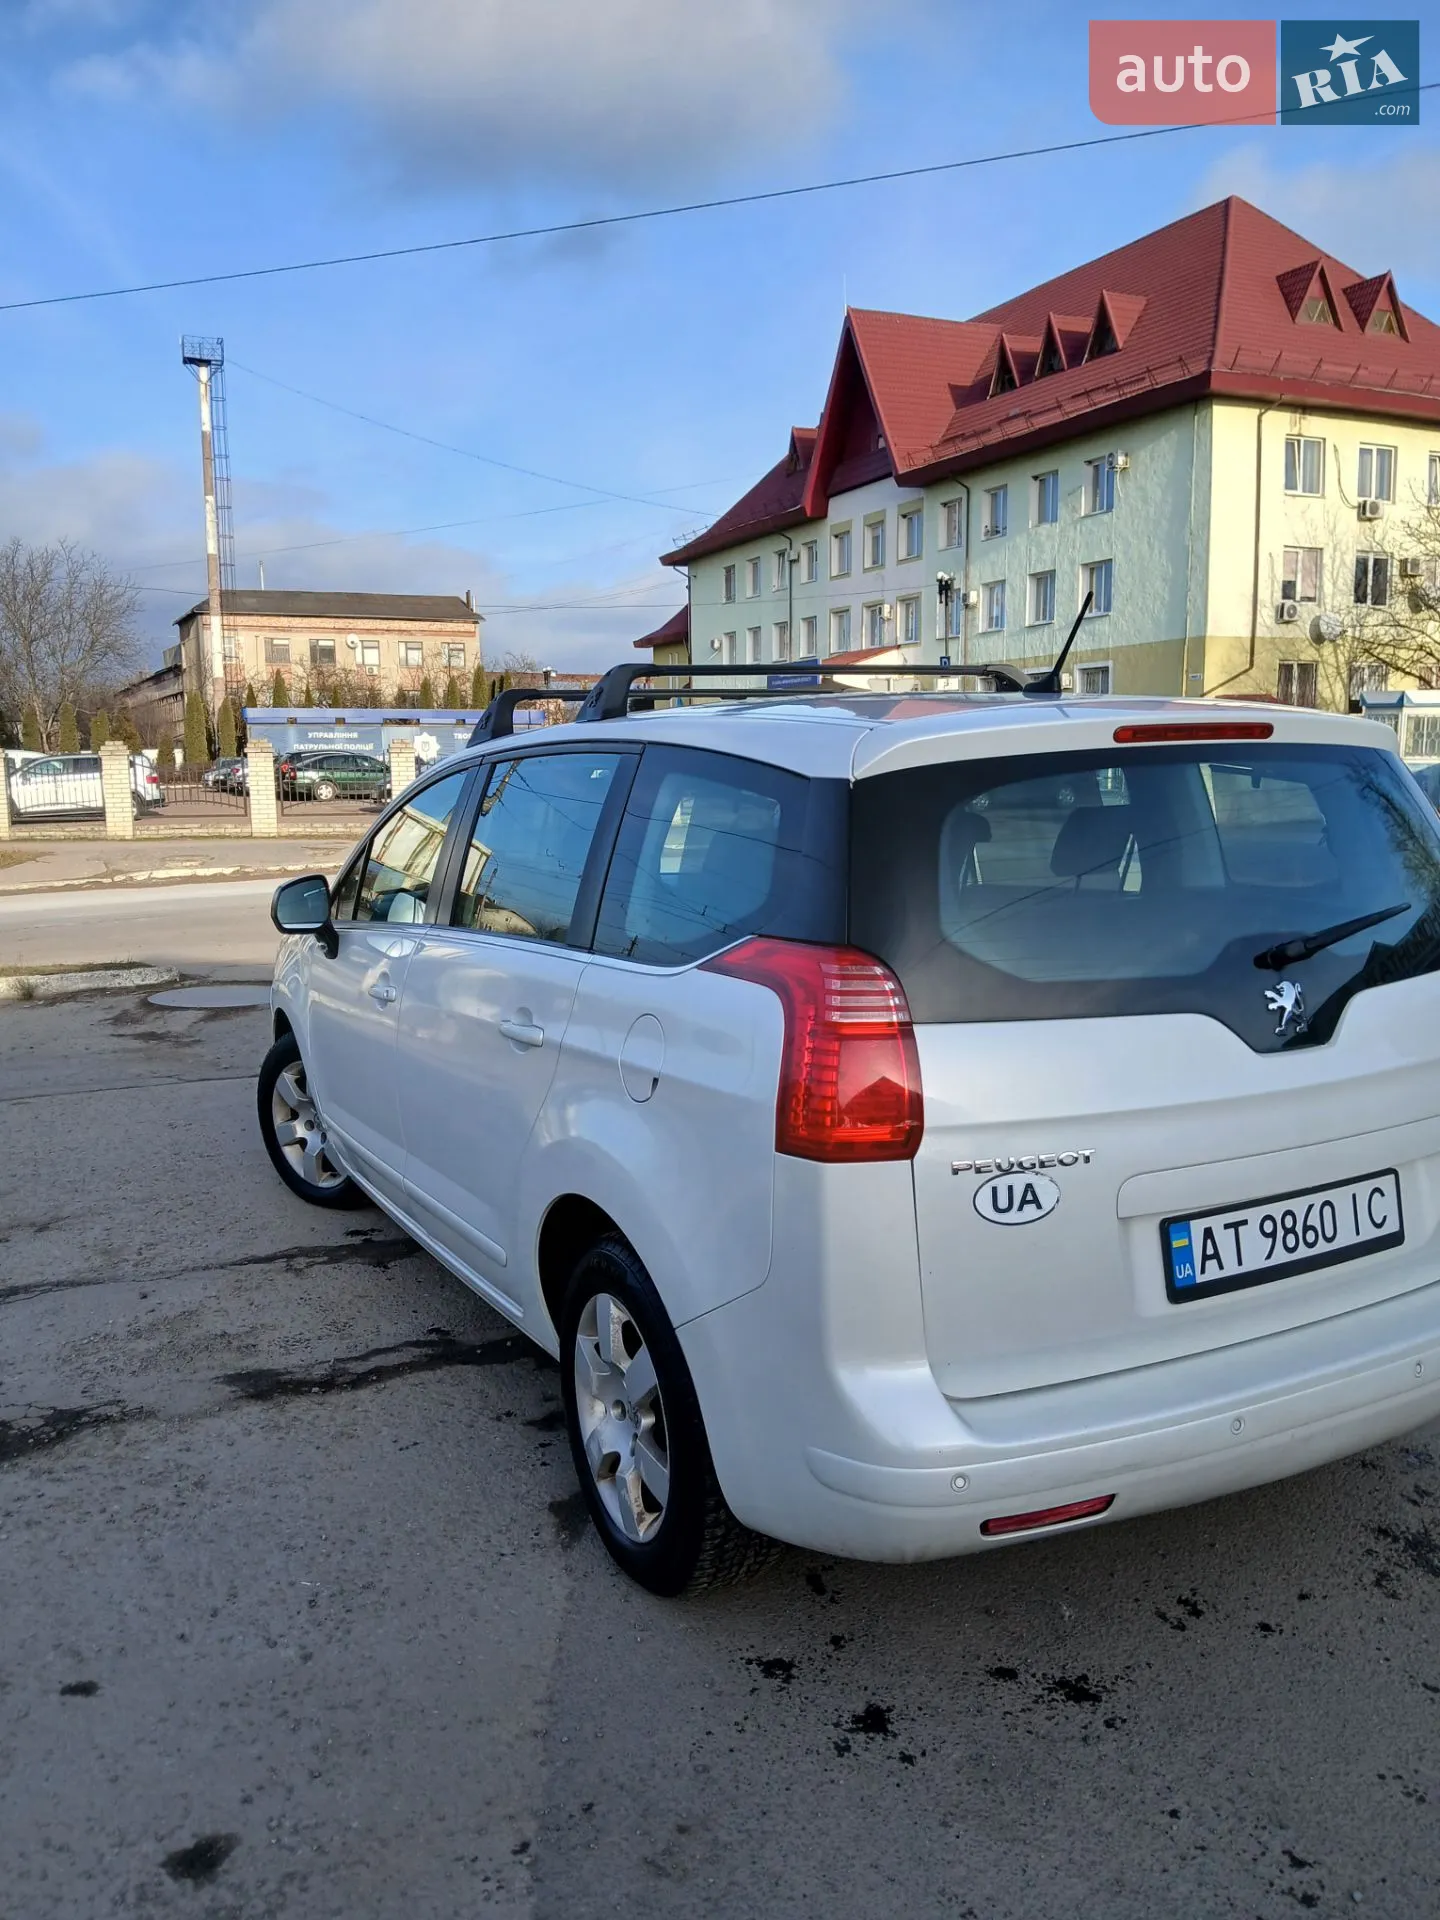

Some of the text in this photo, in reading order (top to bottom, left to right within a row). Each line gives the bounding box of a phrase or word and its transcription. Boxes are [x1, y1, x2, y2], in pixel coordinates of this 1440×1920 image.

[343, 743, 375, 751] ПОЛІЦІЇ
[951, 1148, 1096, 1175] PEUGEOT
[990, 1182, 1043, 1213] UA
[1200, 1186, 1387, 1275] AT 9860 IC
[1175, 1263, 1193, 1279] UA
